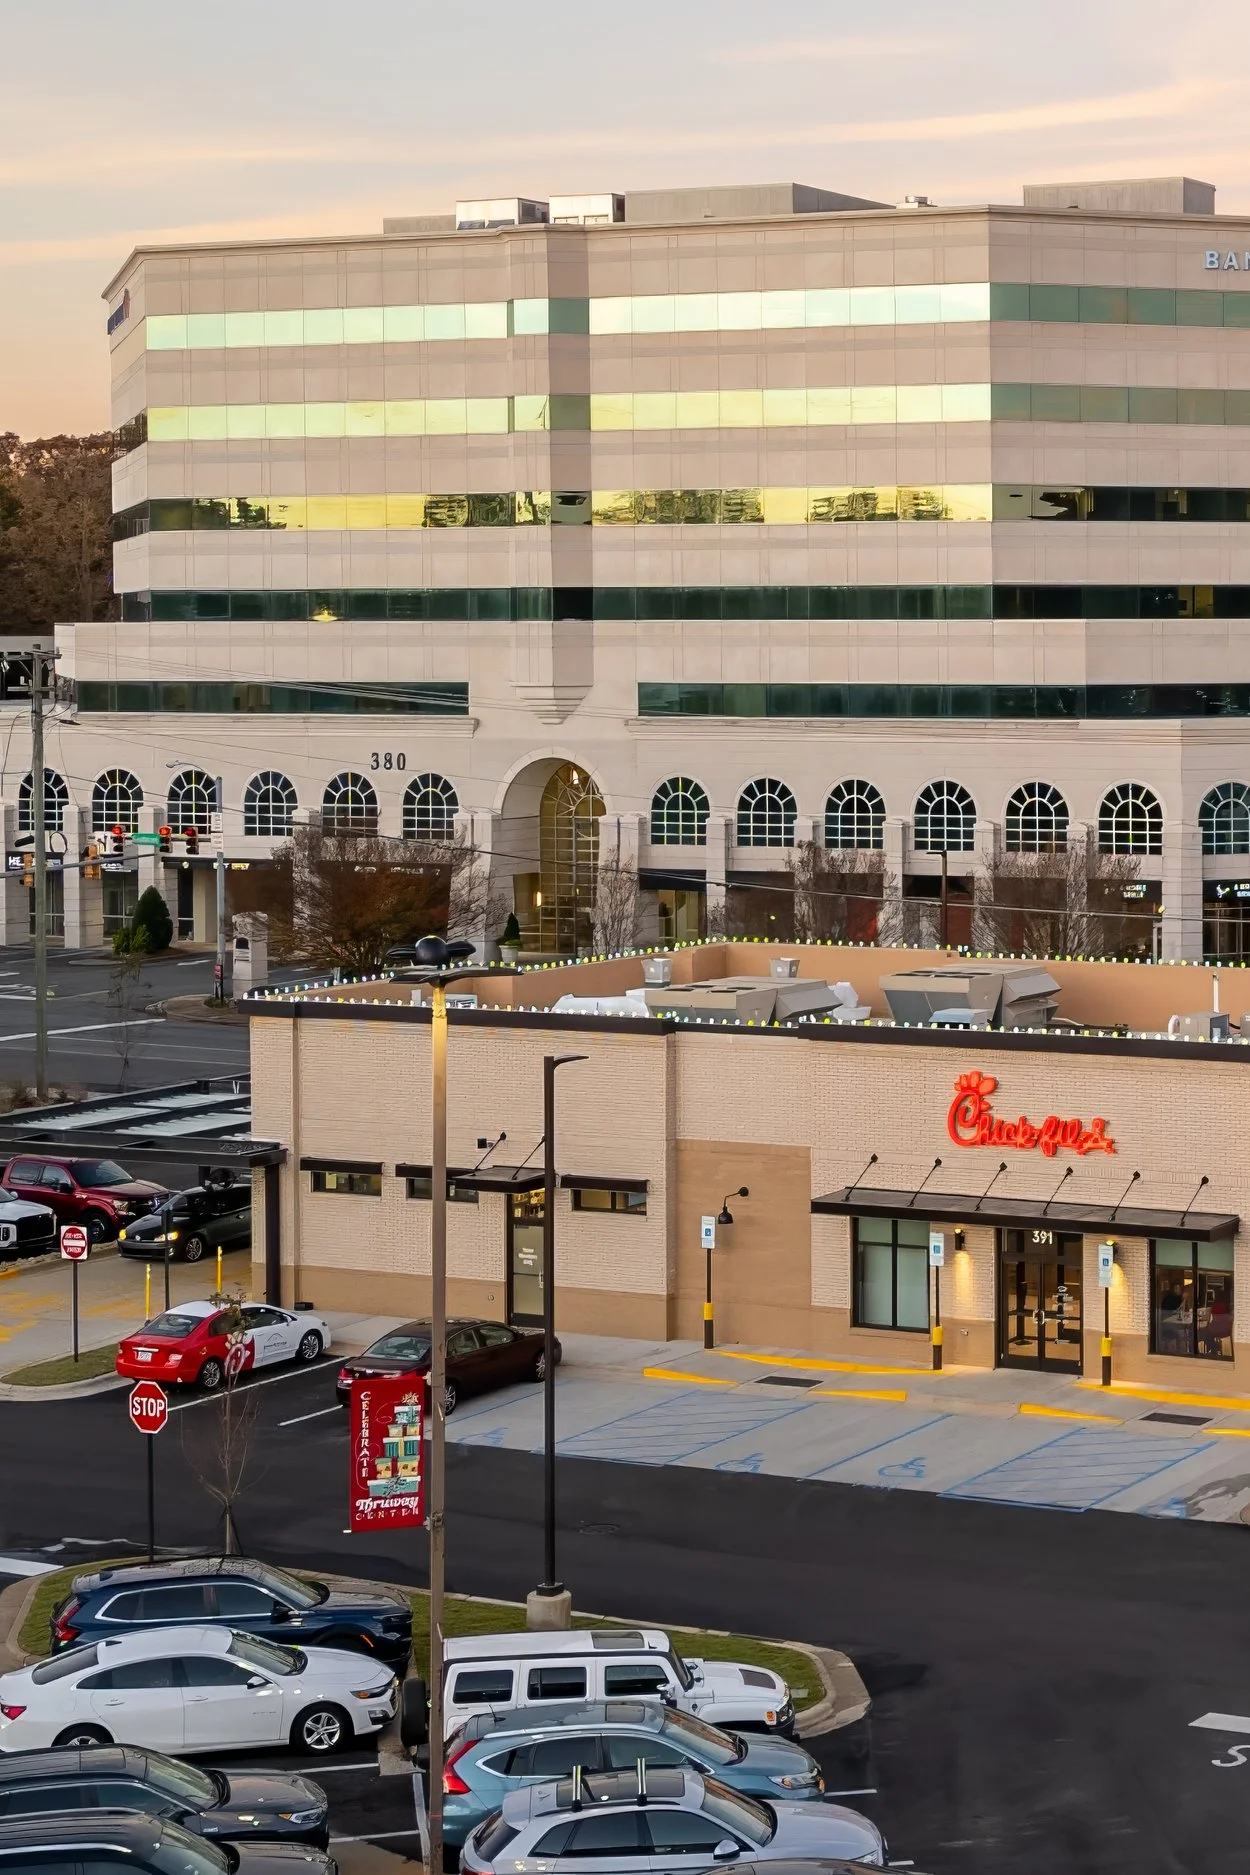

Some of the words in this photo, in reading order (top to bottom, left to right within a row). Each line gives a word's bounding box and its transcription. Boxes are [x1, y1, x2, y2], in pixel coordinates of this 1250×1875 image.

[371, 752, 406, 770] 380
[1032, 1230, 1053, 1244] 391
[133, 1396, 165, 1417] STOP
